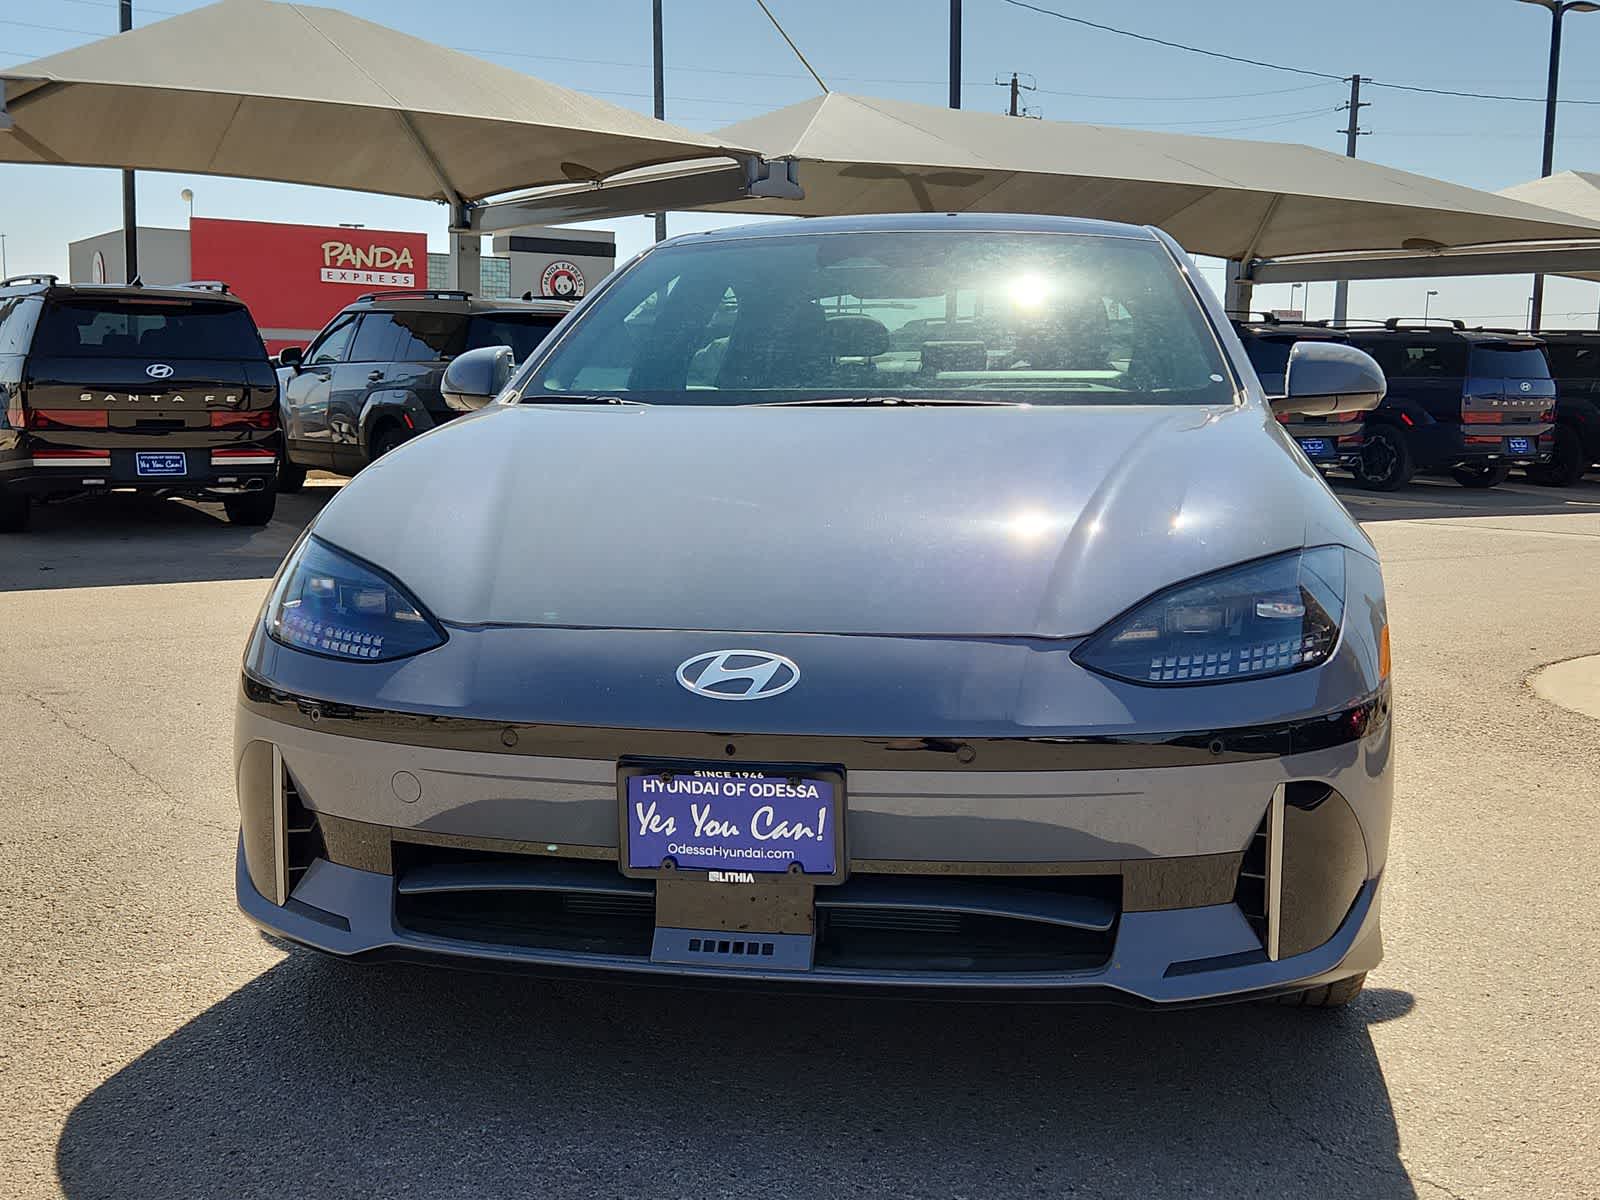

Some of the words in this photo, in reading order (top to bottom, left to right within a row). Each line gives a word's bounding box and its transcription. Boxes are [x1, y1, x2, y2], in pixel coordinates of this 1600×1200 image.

[321, 241, 414, 270] PANDA
[327, 271, 410, 284] EXPRESS
[80, 393, 185, 402] SANTA
[694, 770, 733, 780] SINCE
[735, 771, 765, 780] 1946
[642, 779, 719, 796] HYUNDAI
[722, 782, 746, 797] OF
[749, 783, 819, 799] ODESSA
[636, 802, 677, 836] Yes
[690, 803, 740, 838] You
[750, 805, 827, 842] Can!
[667, 843, 795, 860] OdessaHyundai.com
[720, 871, 755, 884] LITHIA
